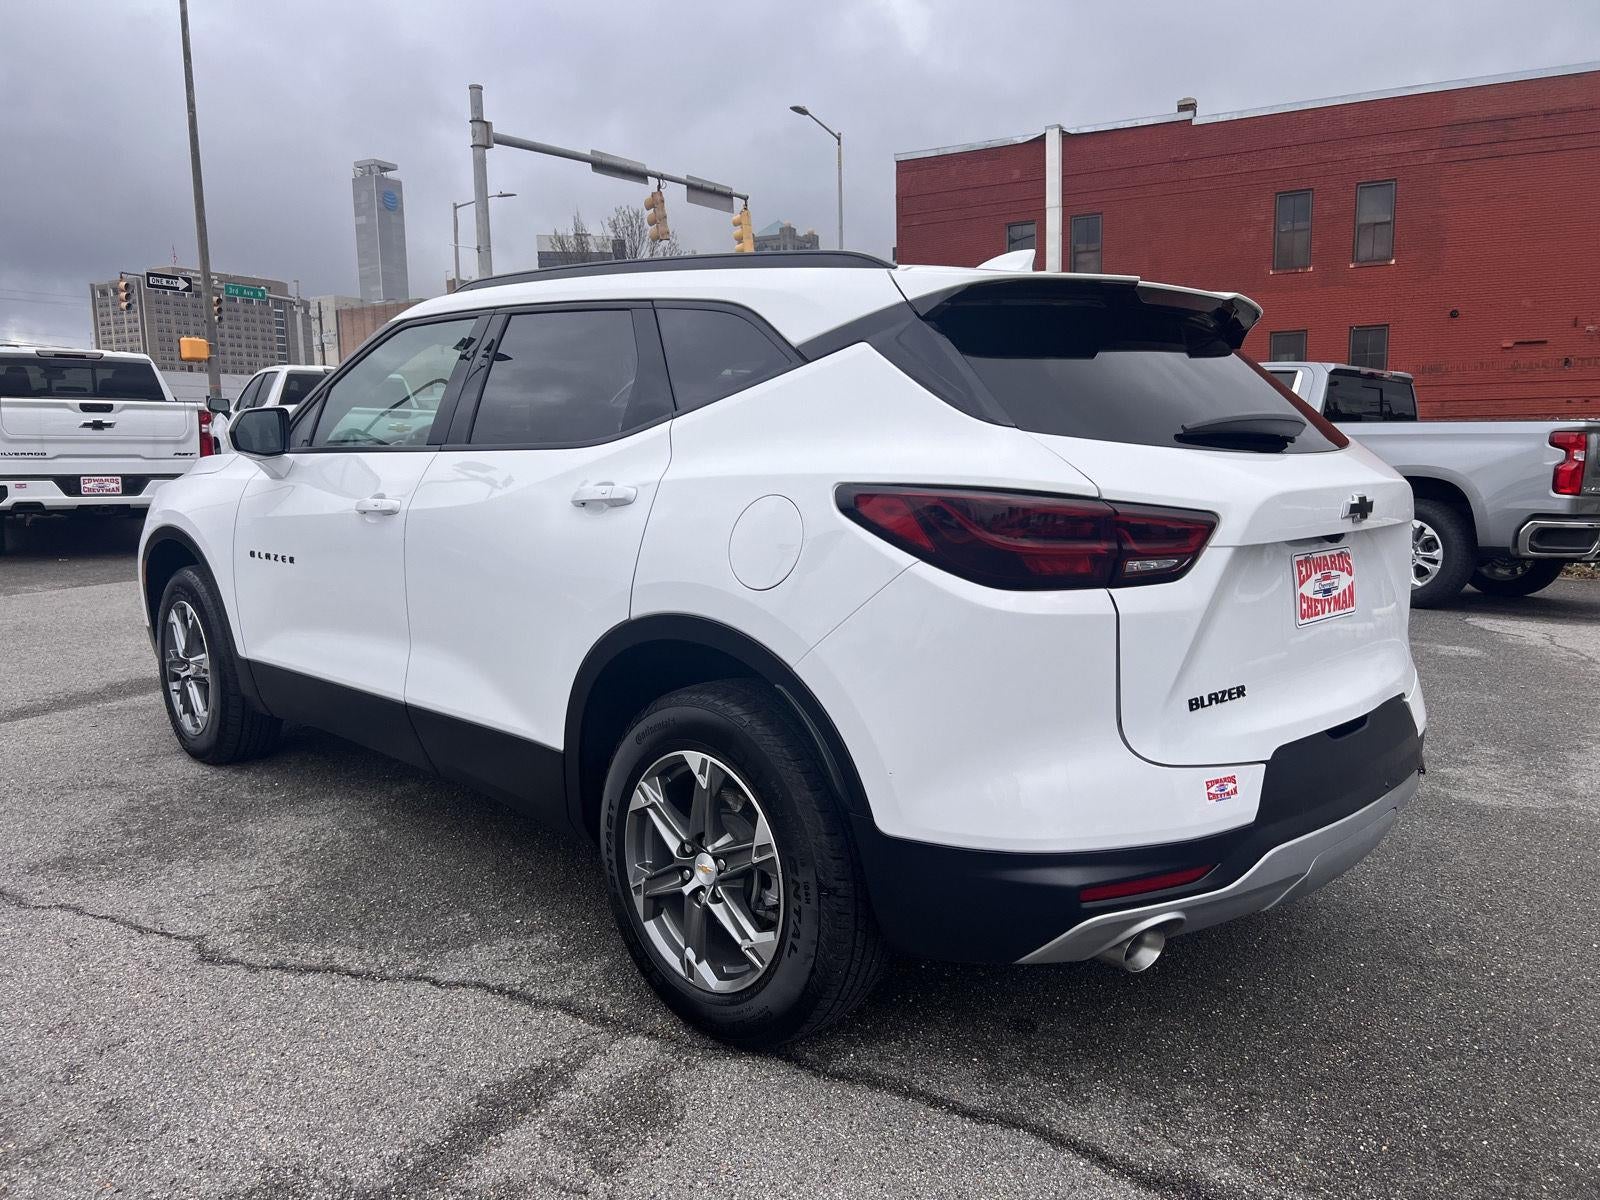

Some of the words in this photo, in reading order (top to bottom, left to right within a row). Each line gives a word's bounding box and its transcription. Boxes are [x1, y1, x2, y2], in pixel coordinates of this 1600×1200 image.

[151, 277, 164, 285] ONE
[166, 279, 179, 287] WAY
[228, 287, 239, 295] 3rd
[243, 288, 254, 296] Ave
[249, 550, 295, 564] BLAZER
[1296, 551, 1353, 589] EDWARDS
[1299, 580, 1355, 620] CHEVYMAN
[1187, 684, 1246, 712] BLAZER
